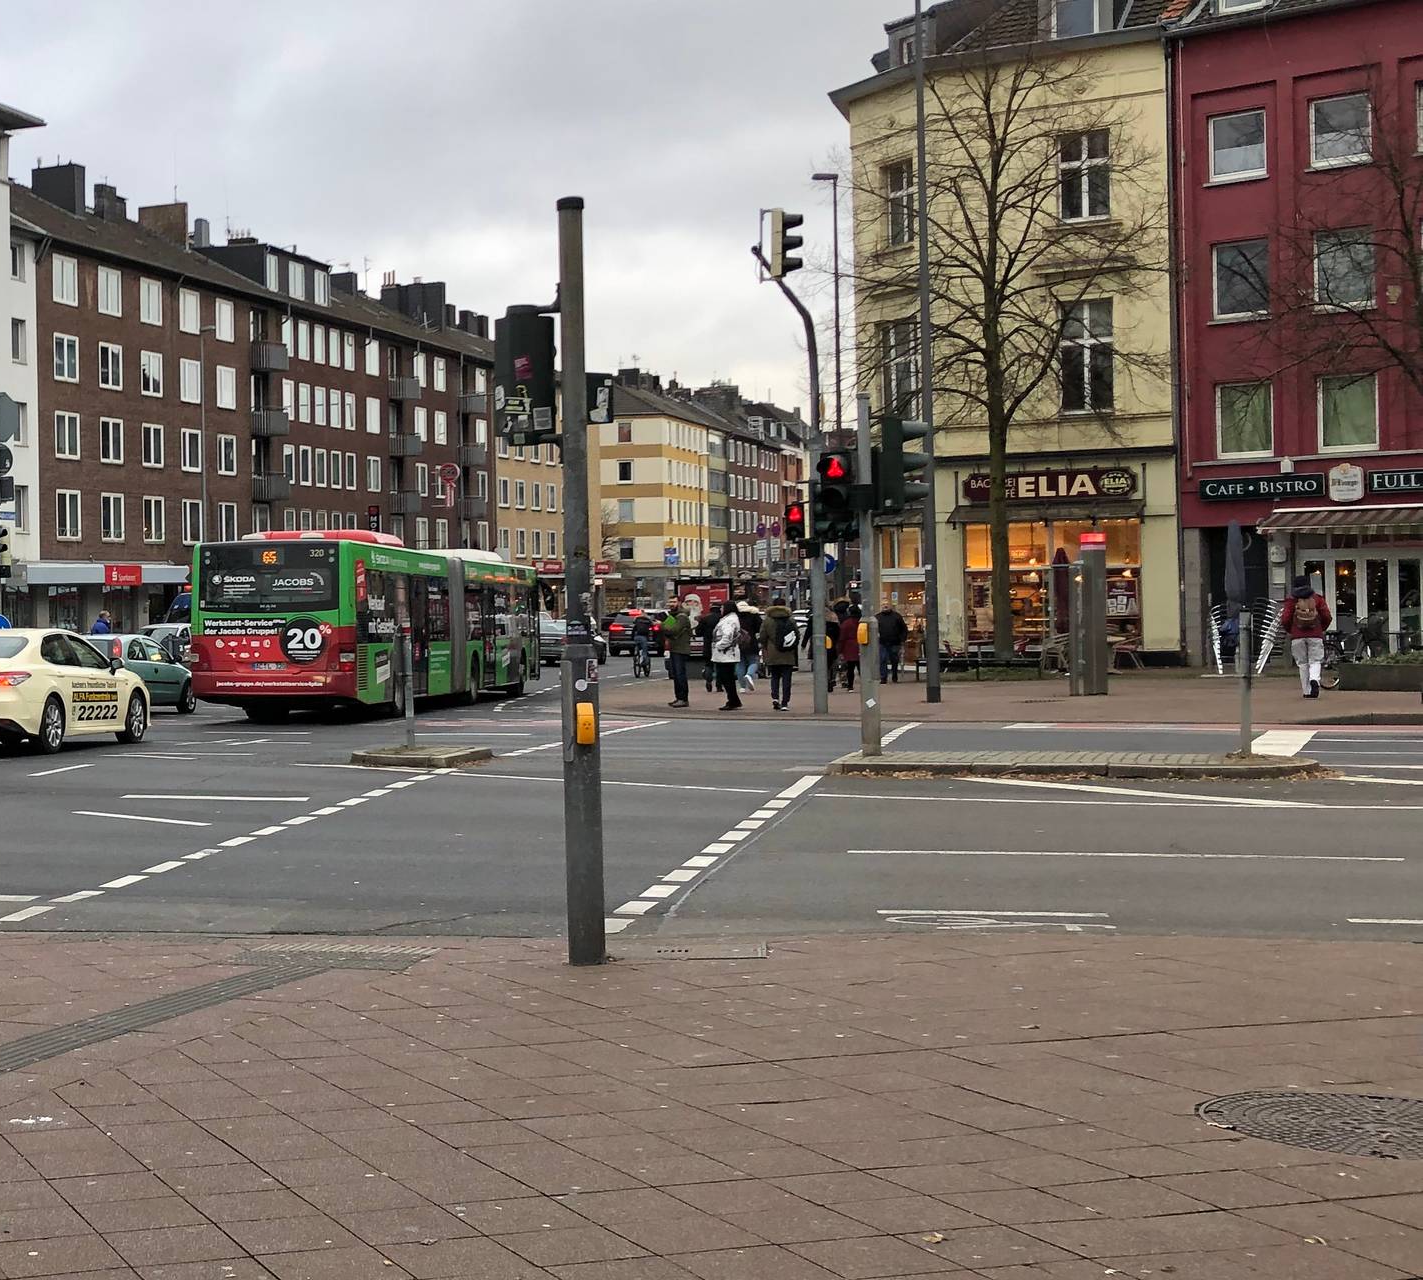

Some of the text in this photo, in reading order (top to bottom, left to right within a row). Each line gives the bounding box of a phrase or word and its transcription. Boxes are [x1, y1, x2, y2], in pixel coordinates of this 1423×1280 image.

[1104, 478, 1127, 486] ELIA
[1373, 473, 1421, 489] FULL
[1018, 474, 1097, 498] ELIA
[310, 549, 325, 557] 320
[272, 578, 314, 587] JACOBS
[246, 628, 277, 636] Gruppe!
[77, 704, 118, 720] 22222
